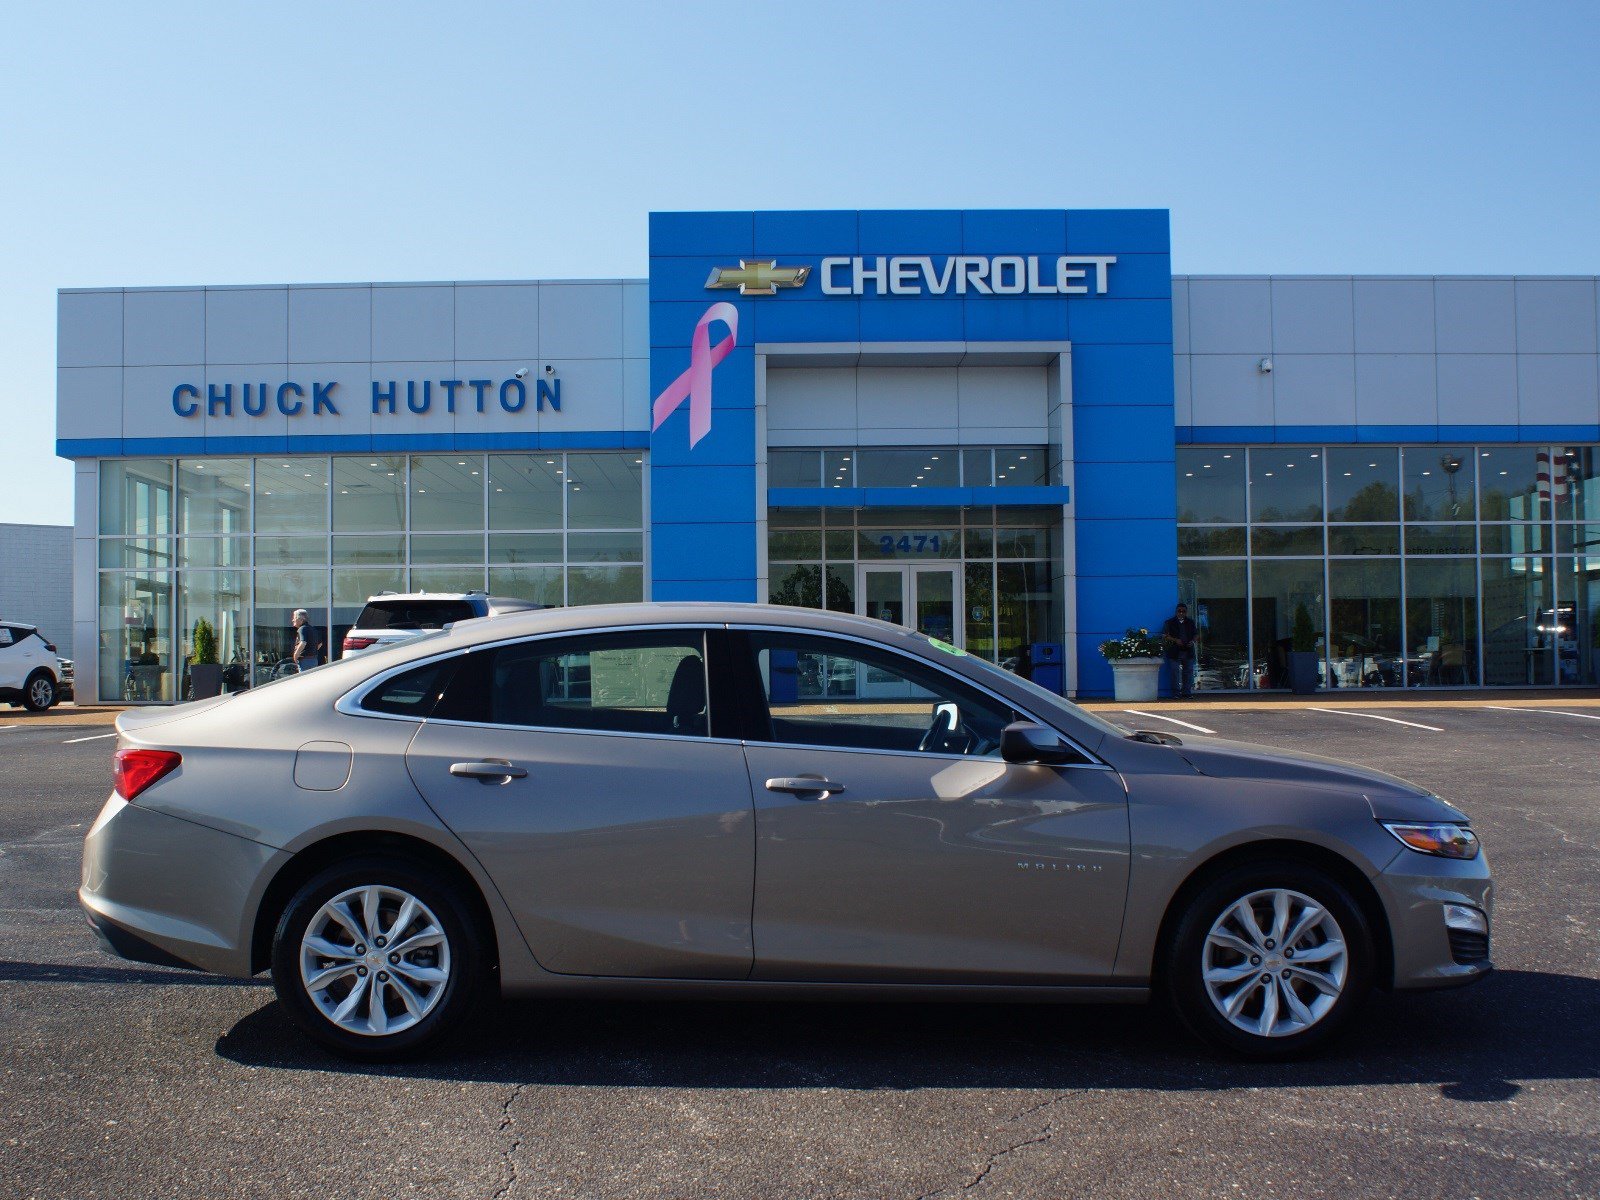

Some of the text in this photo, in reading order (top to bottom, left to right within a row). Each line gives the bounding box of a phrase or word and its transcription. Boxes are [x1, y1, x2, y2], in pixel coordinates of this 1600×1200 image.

[820, 256, 1117, 295] CHEVROLET
[172, 378, 562, 417] CHUCK HUTTON
[880, 535, 940, 553] 2471
